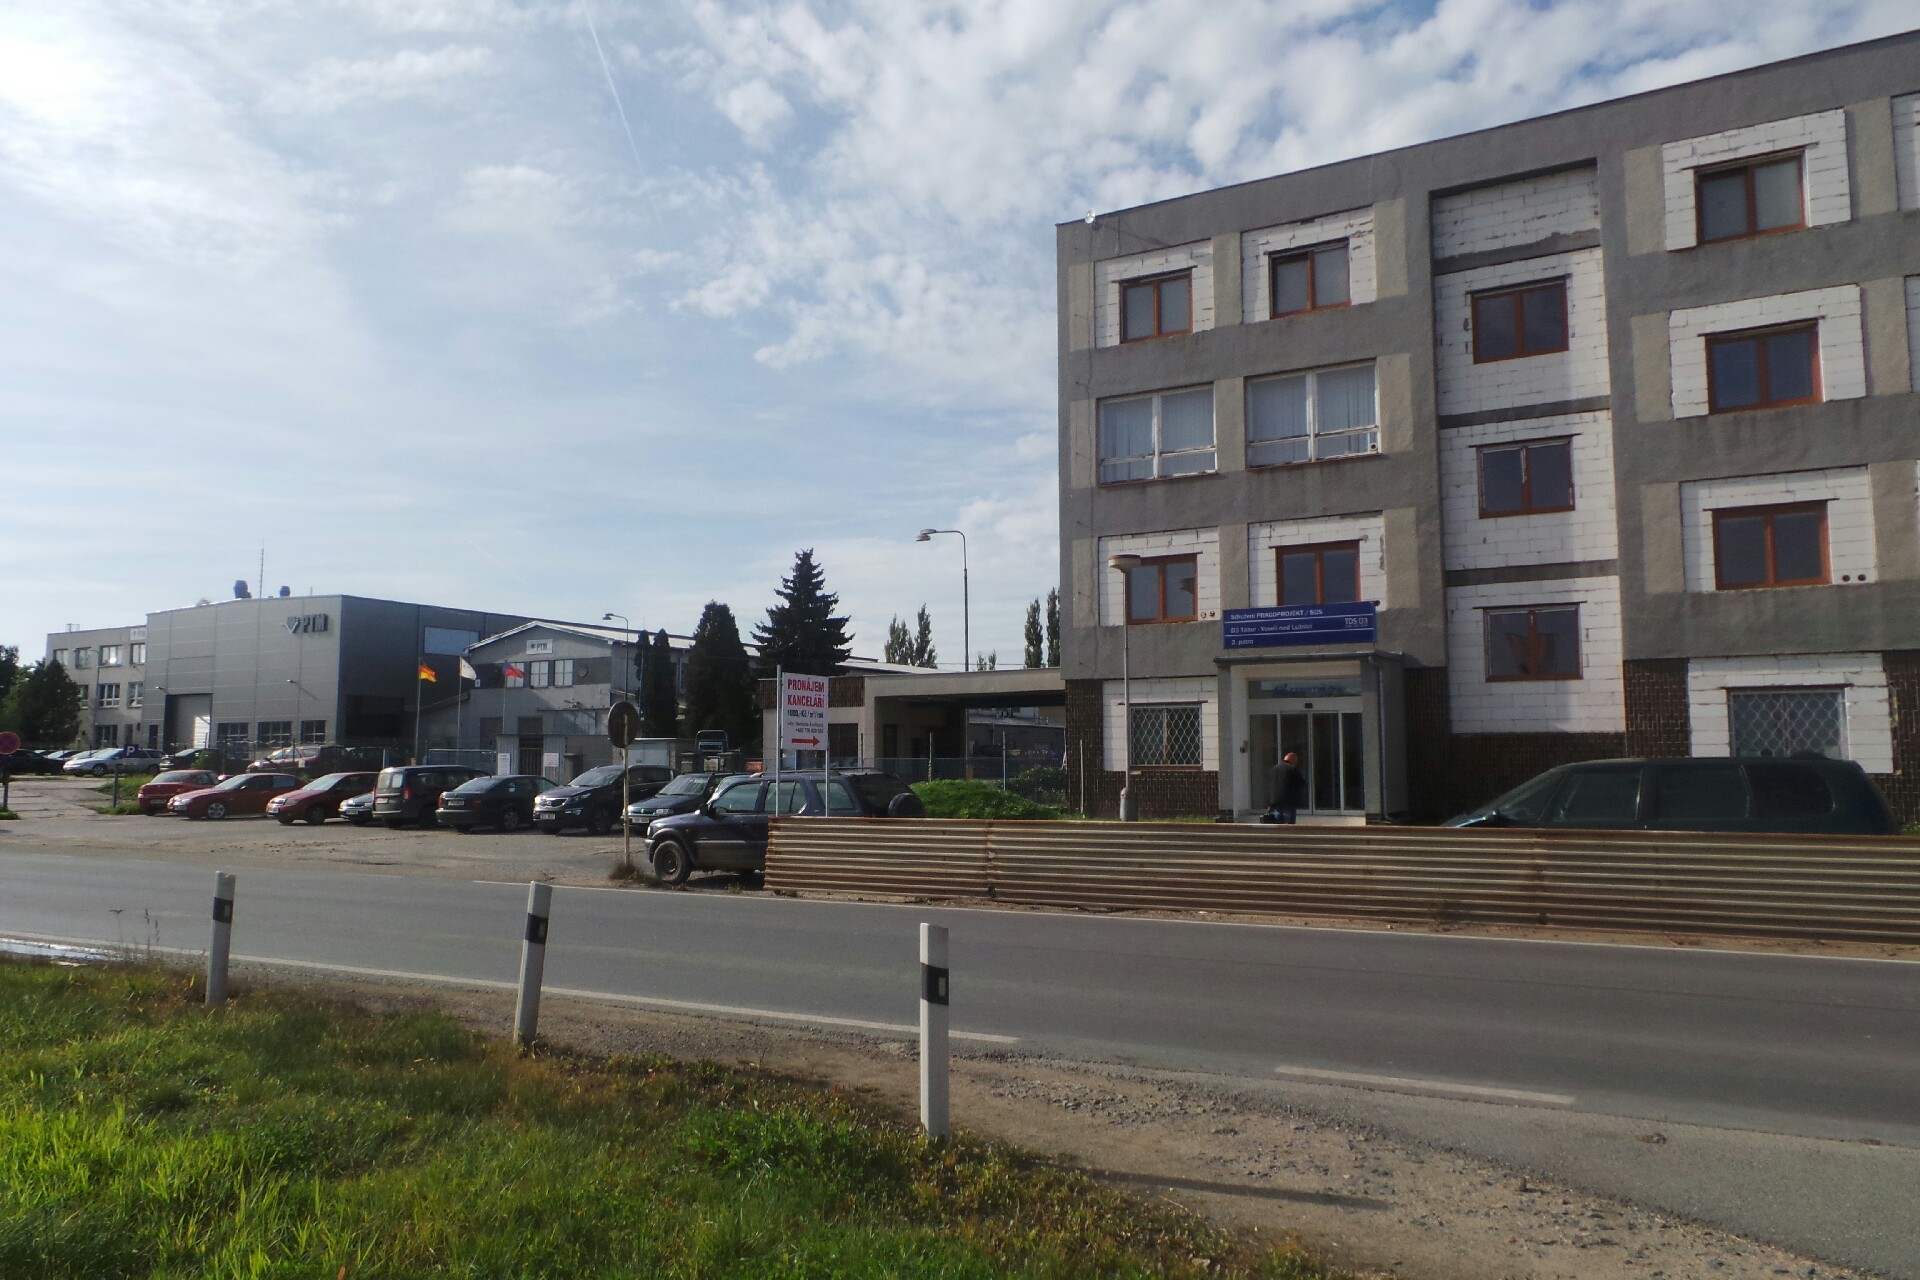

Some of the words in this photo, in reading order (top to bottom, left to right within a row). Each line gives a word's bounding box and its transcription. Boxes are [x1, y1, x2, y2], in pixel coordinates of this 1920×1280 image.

[1344, 617, 1357, 625] TDS
[787, 677, 825, 693] PRONÁJEM
[787, 694, 825, 708] KANCELÁŘÍ
